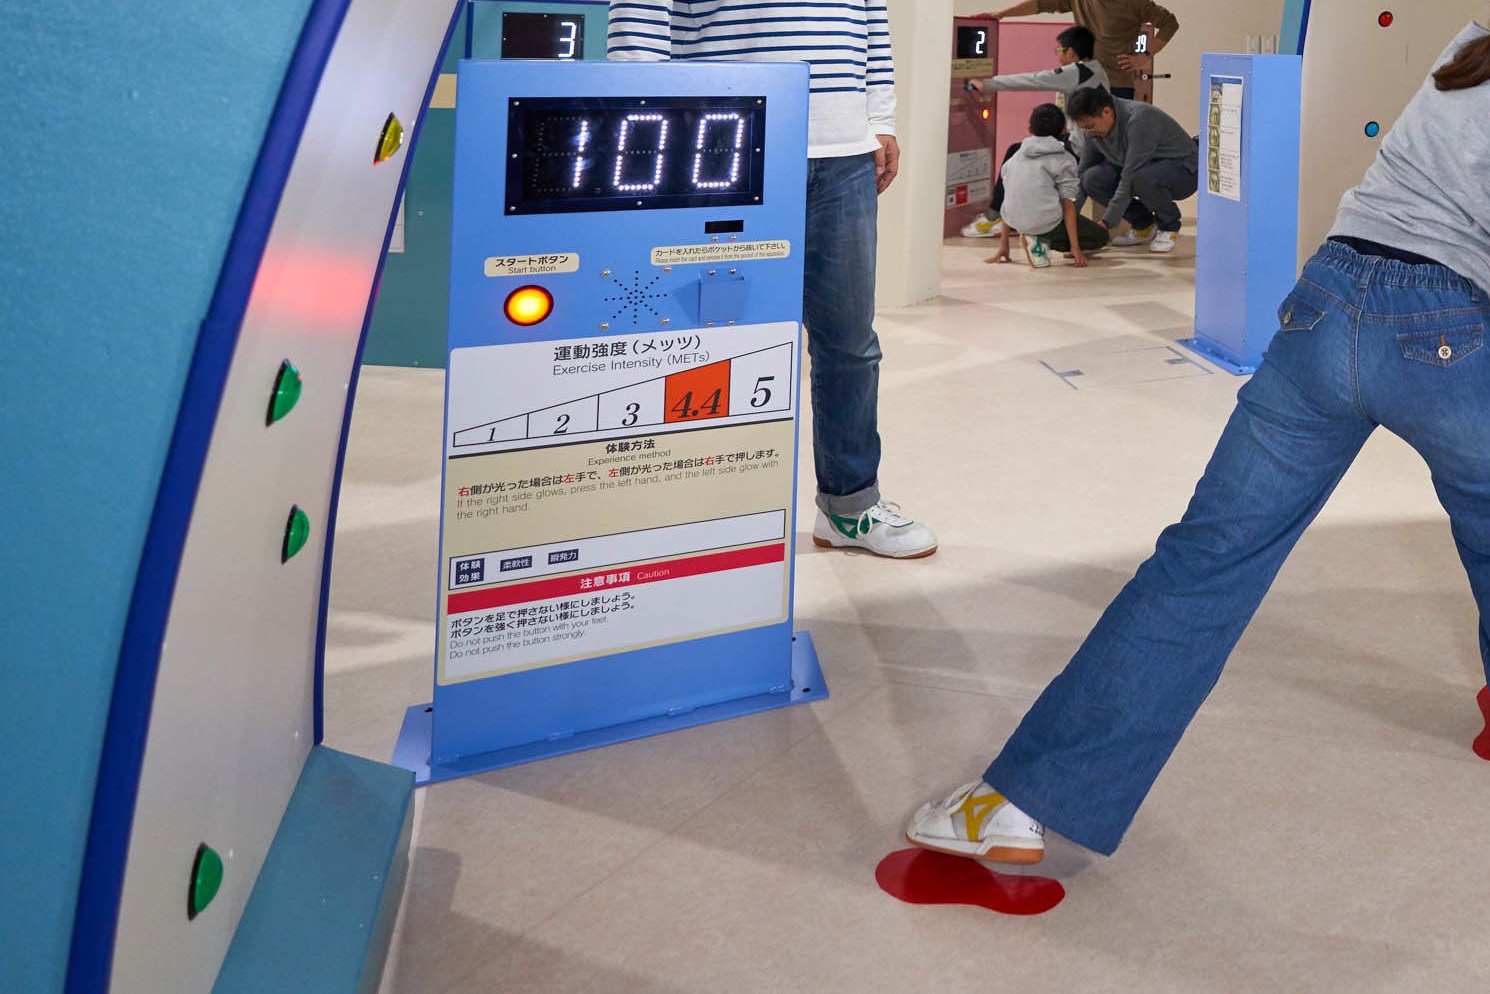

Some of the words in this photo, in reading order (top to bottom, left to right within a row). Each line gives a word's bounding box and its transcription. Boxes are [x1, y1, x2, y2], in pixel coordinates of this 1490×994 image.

[558, 21, 577, 58] 3
[975, 30, 986, 54] 2
[572, 113, 746, 192] 100
[495, 255, 569, 268] スタートボタン
[508, 266, 528, 274] Start
[529, 265, 557, 273] button
[553, 334, 701, 362] 運動強度（メッツ）
[552, 362, 606, 376] Exercise
[611, 356, 663, 371] Intensity
[667, 350, 710, 366] (METs)
[488, 427, 497, 442] 1
[552, 414, 571, 435] 2
[621, 402, 641, 427] 3
[670, 388, 723, 420] 4.4
[749, 375, 776, 408] 5
[588, 453, 637, 466] Experience
[639, 448, 672, 460] method
[606, 438, 656, 454] 体験方法
[467, 497, 484, 507] the
[486, 493, 509, 505] right
[512, 490, 533, 501] side
[570, 485, 598, 496] press
[600, 480, 615, 490] the
[665, 471, 682, 481] and
[685, 468, 700, 478] the
[718, 464, 737, 474] side
[739, 461, 759, 474] glow
[762, 459, 779, 469] with
[457, 509, 473, 520] the
[476, 505, 499, 518] right
[580, 572, 632, 589] 注意事項
[637, 568, 671, 580] Caution
[449, 650, 464, 660] Do
[466, 647, 480, 657] not
[482, 643, 505, 656] push
[507, 640, 521, 649] the
[522, 635, 550, 646] button
[450, 640, 464, 650] Do
[466, 638, 480, 648] not
[482, 634, 505, 647] push
[507, 630, 521, 640] the
[523, 625, 550, 637] button
[552, 621, 570, 632] with
[571, 620, 590, 631] your
